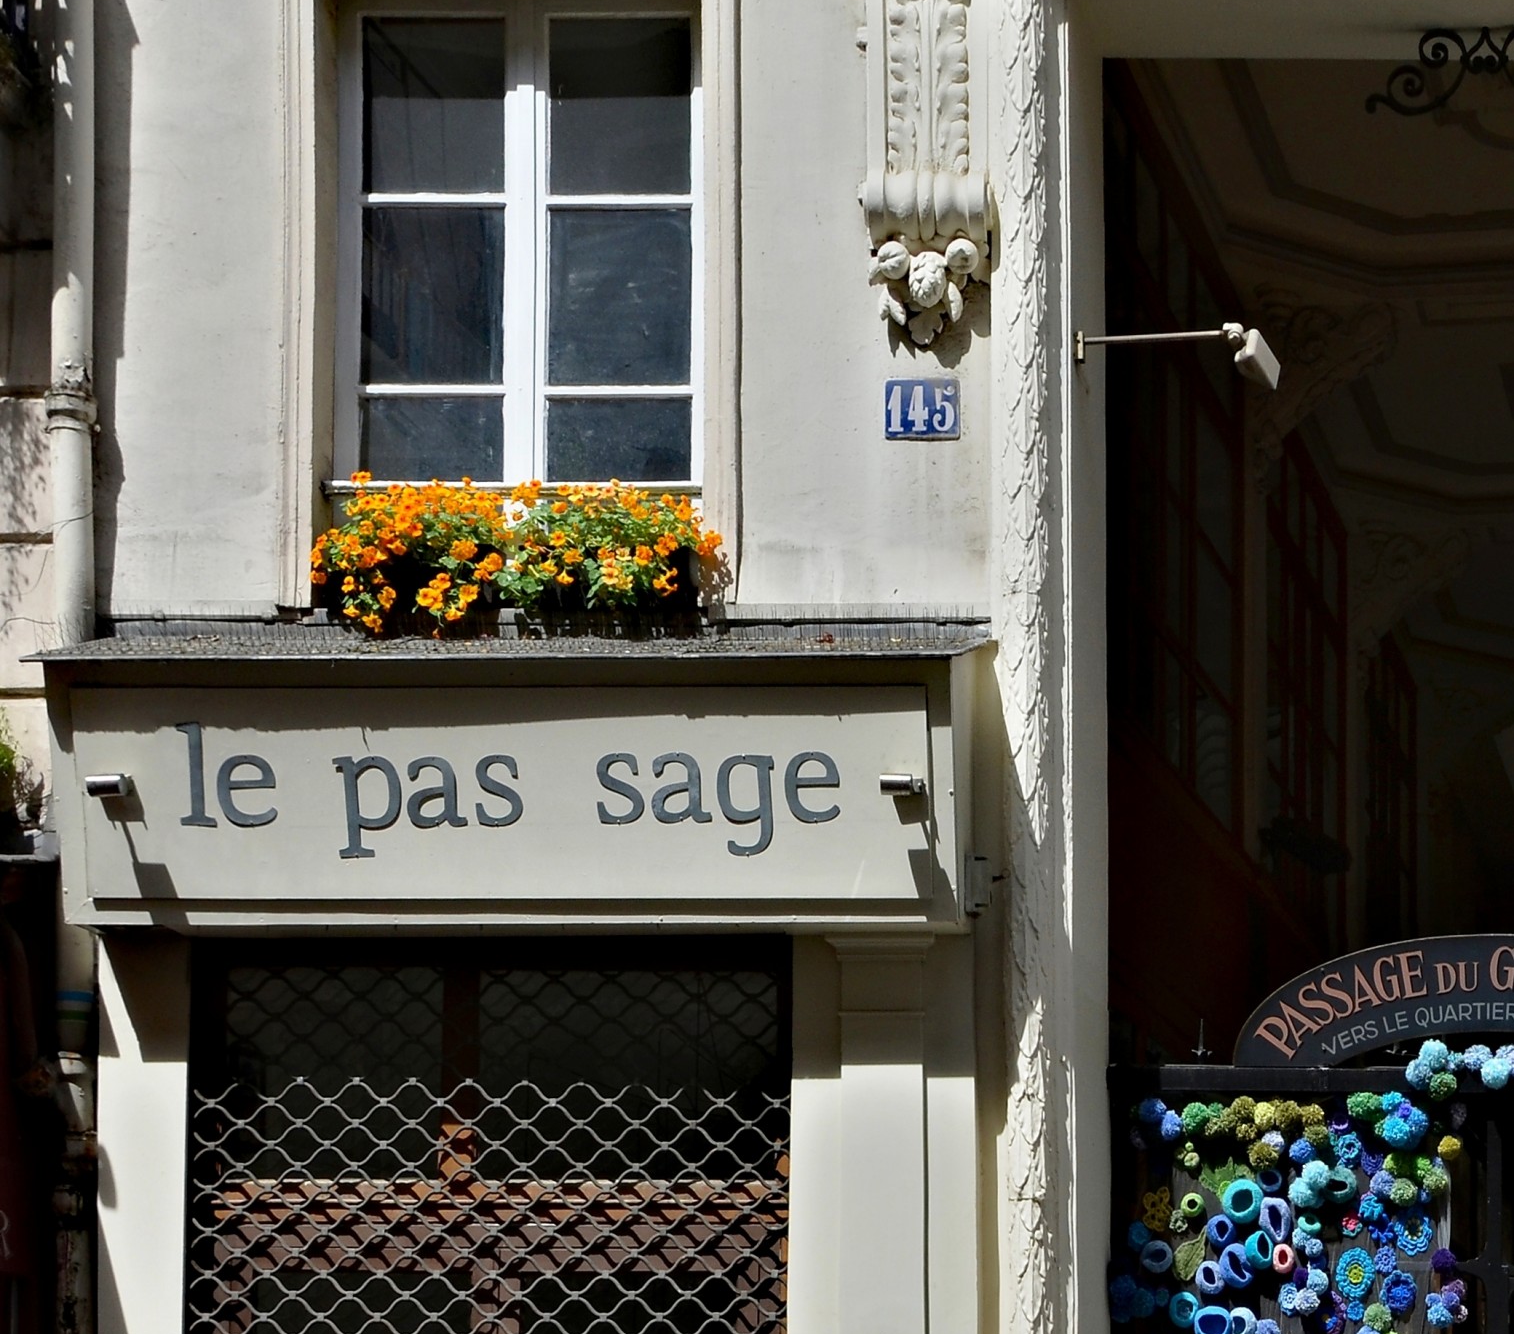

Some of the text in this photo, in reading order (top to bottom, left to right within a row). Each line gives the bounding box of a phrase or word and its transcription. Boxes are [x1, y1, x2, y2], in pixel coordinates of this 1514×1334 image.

[887, 385, 955, 432] 145
[174, 721, 842, 859] le pas sage
[1254, 950, 1427, 1061] PASSAGE
[1434, 961, 1480, 995] DU
[1321, 1017, 1380, 1055] VERS
[1383, 1010, 1408, 1033] LE
